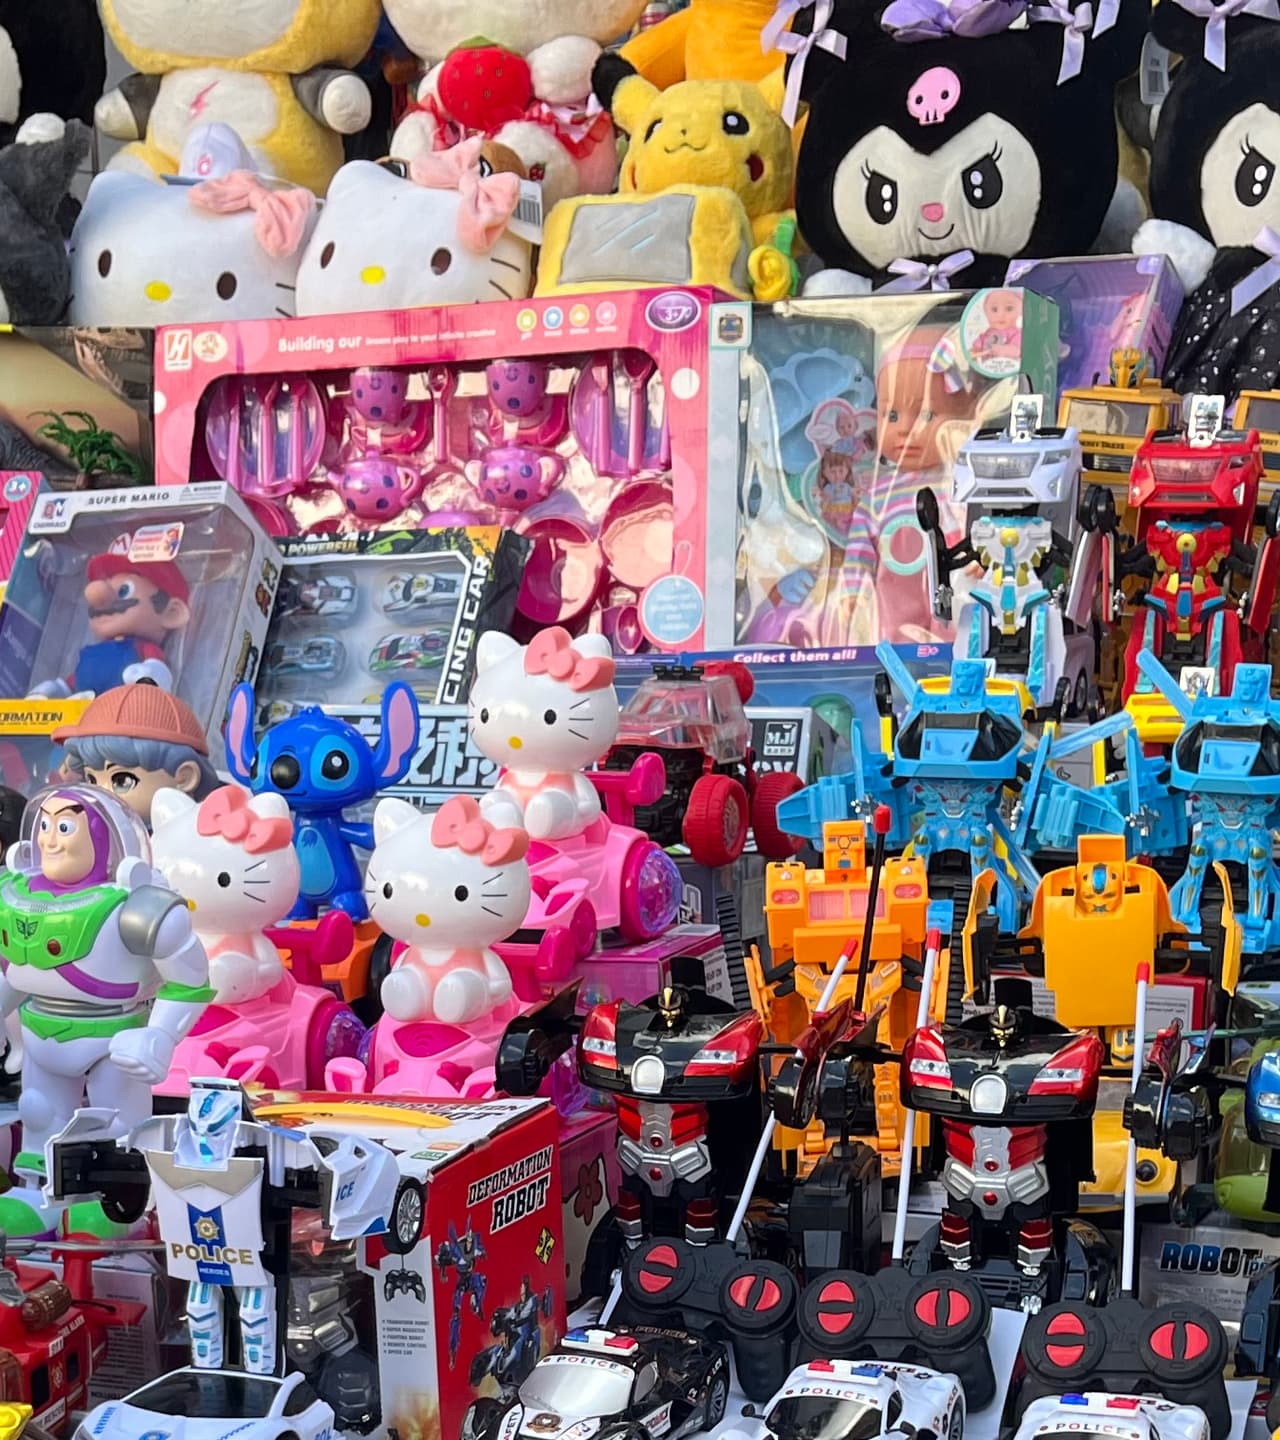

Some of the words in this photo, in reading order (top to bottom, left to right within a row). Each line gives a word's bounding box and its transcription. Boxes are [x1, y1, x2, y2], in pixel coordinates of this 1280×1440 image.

[278, 336, 334, 353] Building
[339, 336, 361, 348] our
[88, 495, 127, 506] SUPER
[131, 492, 170, 502] MARIO
[463, 556, 492, 621] CAR
[733, 651, 785, 664] Collect
[790, 650, 828, 662] them
[466, 1143, 554, 1208] DEFORMATION
[490, 1172, 553, 1235] ROBOT
[170, 1242, 254, 1265] POLICE
[1158, 1241, 1261, 1277] ROBOT
[555, 1354, 619, 1371] POLICE
[799, 1386, 867, 1402] POLICE
[1055, 1421, 1123, 1436] POLICE
